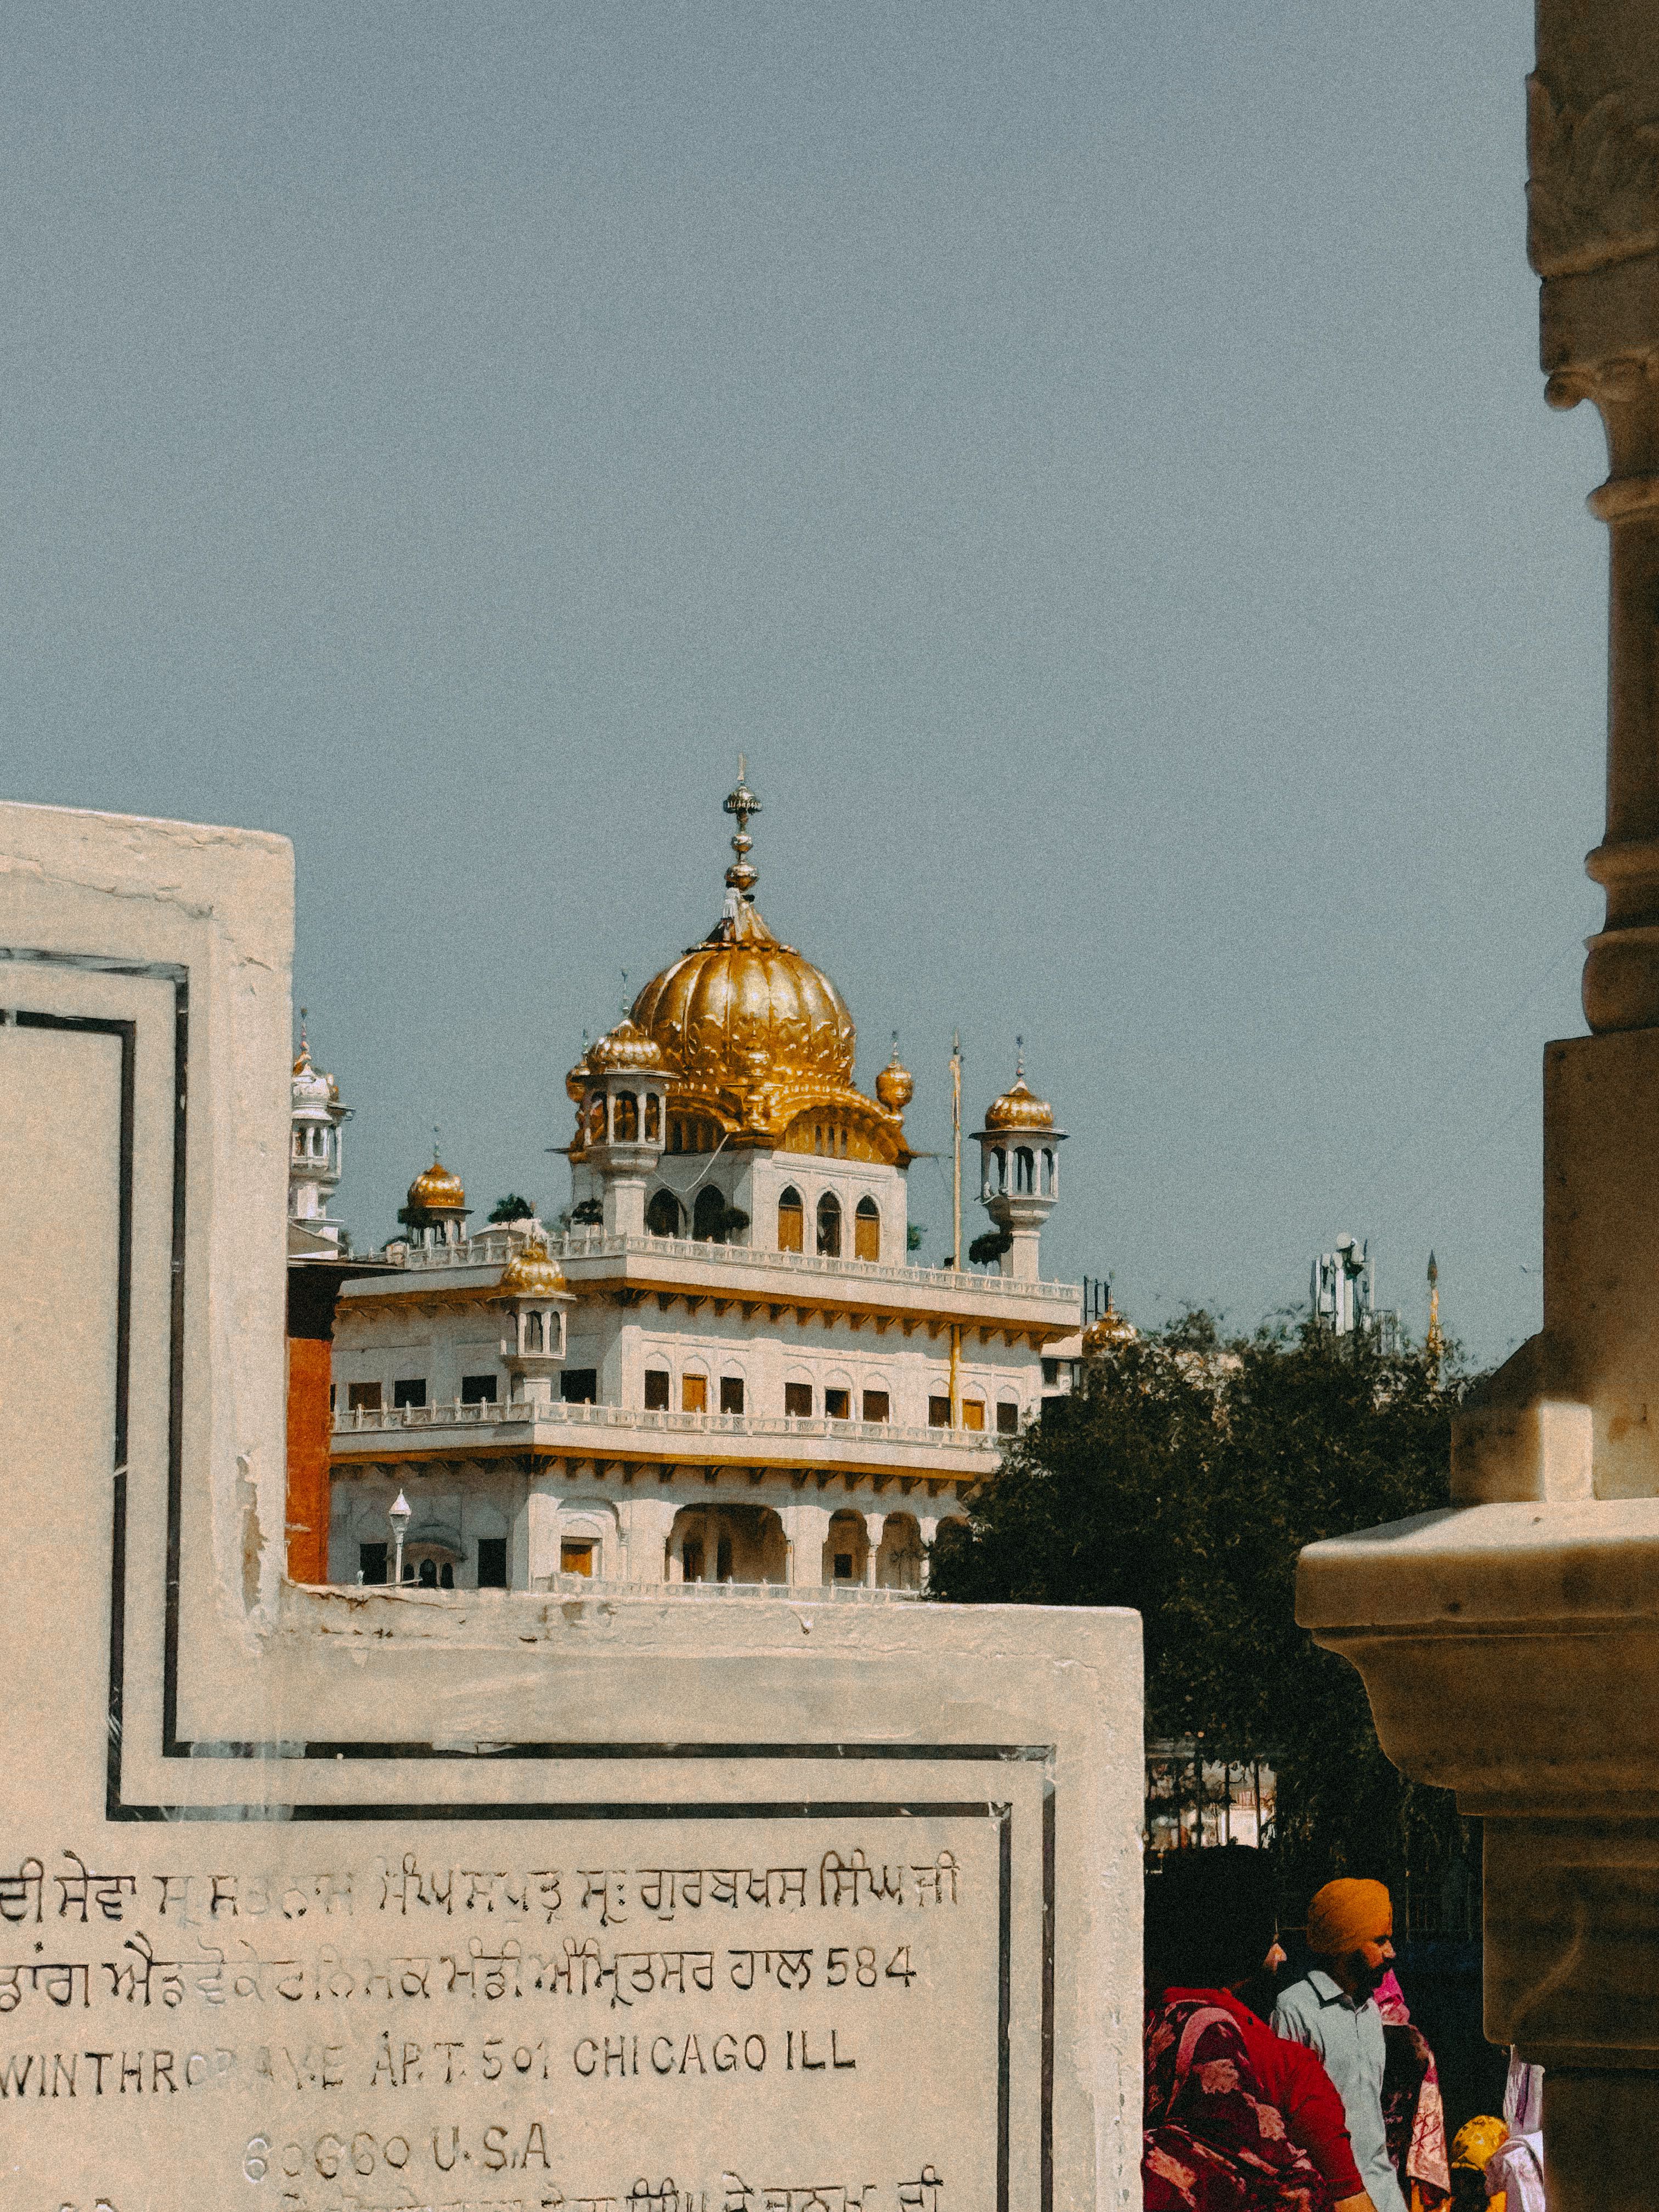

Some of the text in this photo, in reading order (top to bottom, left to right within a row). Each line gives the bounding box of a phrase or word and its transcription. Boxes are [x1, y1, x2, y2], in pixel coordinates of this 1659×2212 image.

[54, 1849, 136, 1922] ਸੇਵਾ
[821, 1848, 904, 1907] ਸਿੰਘ
[910, 1850, 960, 1907] ਜੀ
[728, 1949, 813, 1990] ਹਾਲ
[827, 1945, 917, 1987] 584
[482, 2036, 549, 2080] 501
[573, 2032, 766, 2077] CHICAGO
[787, 2029, 856, 2071] ILL
